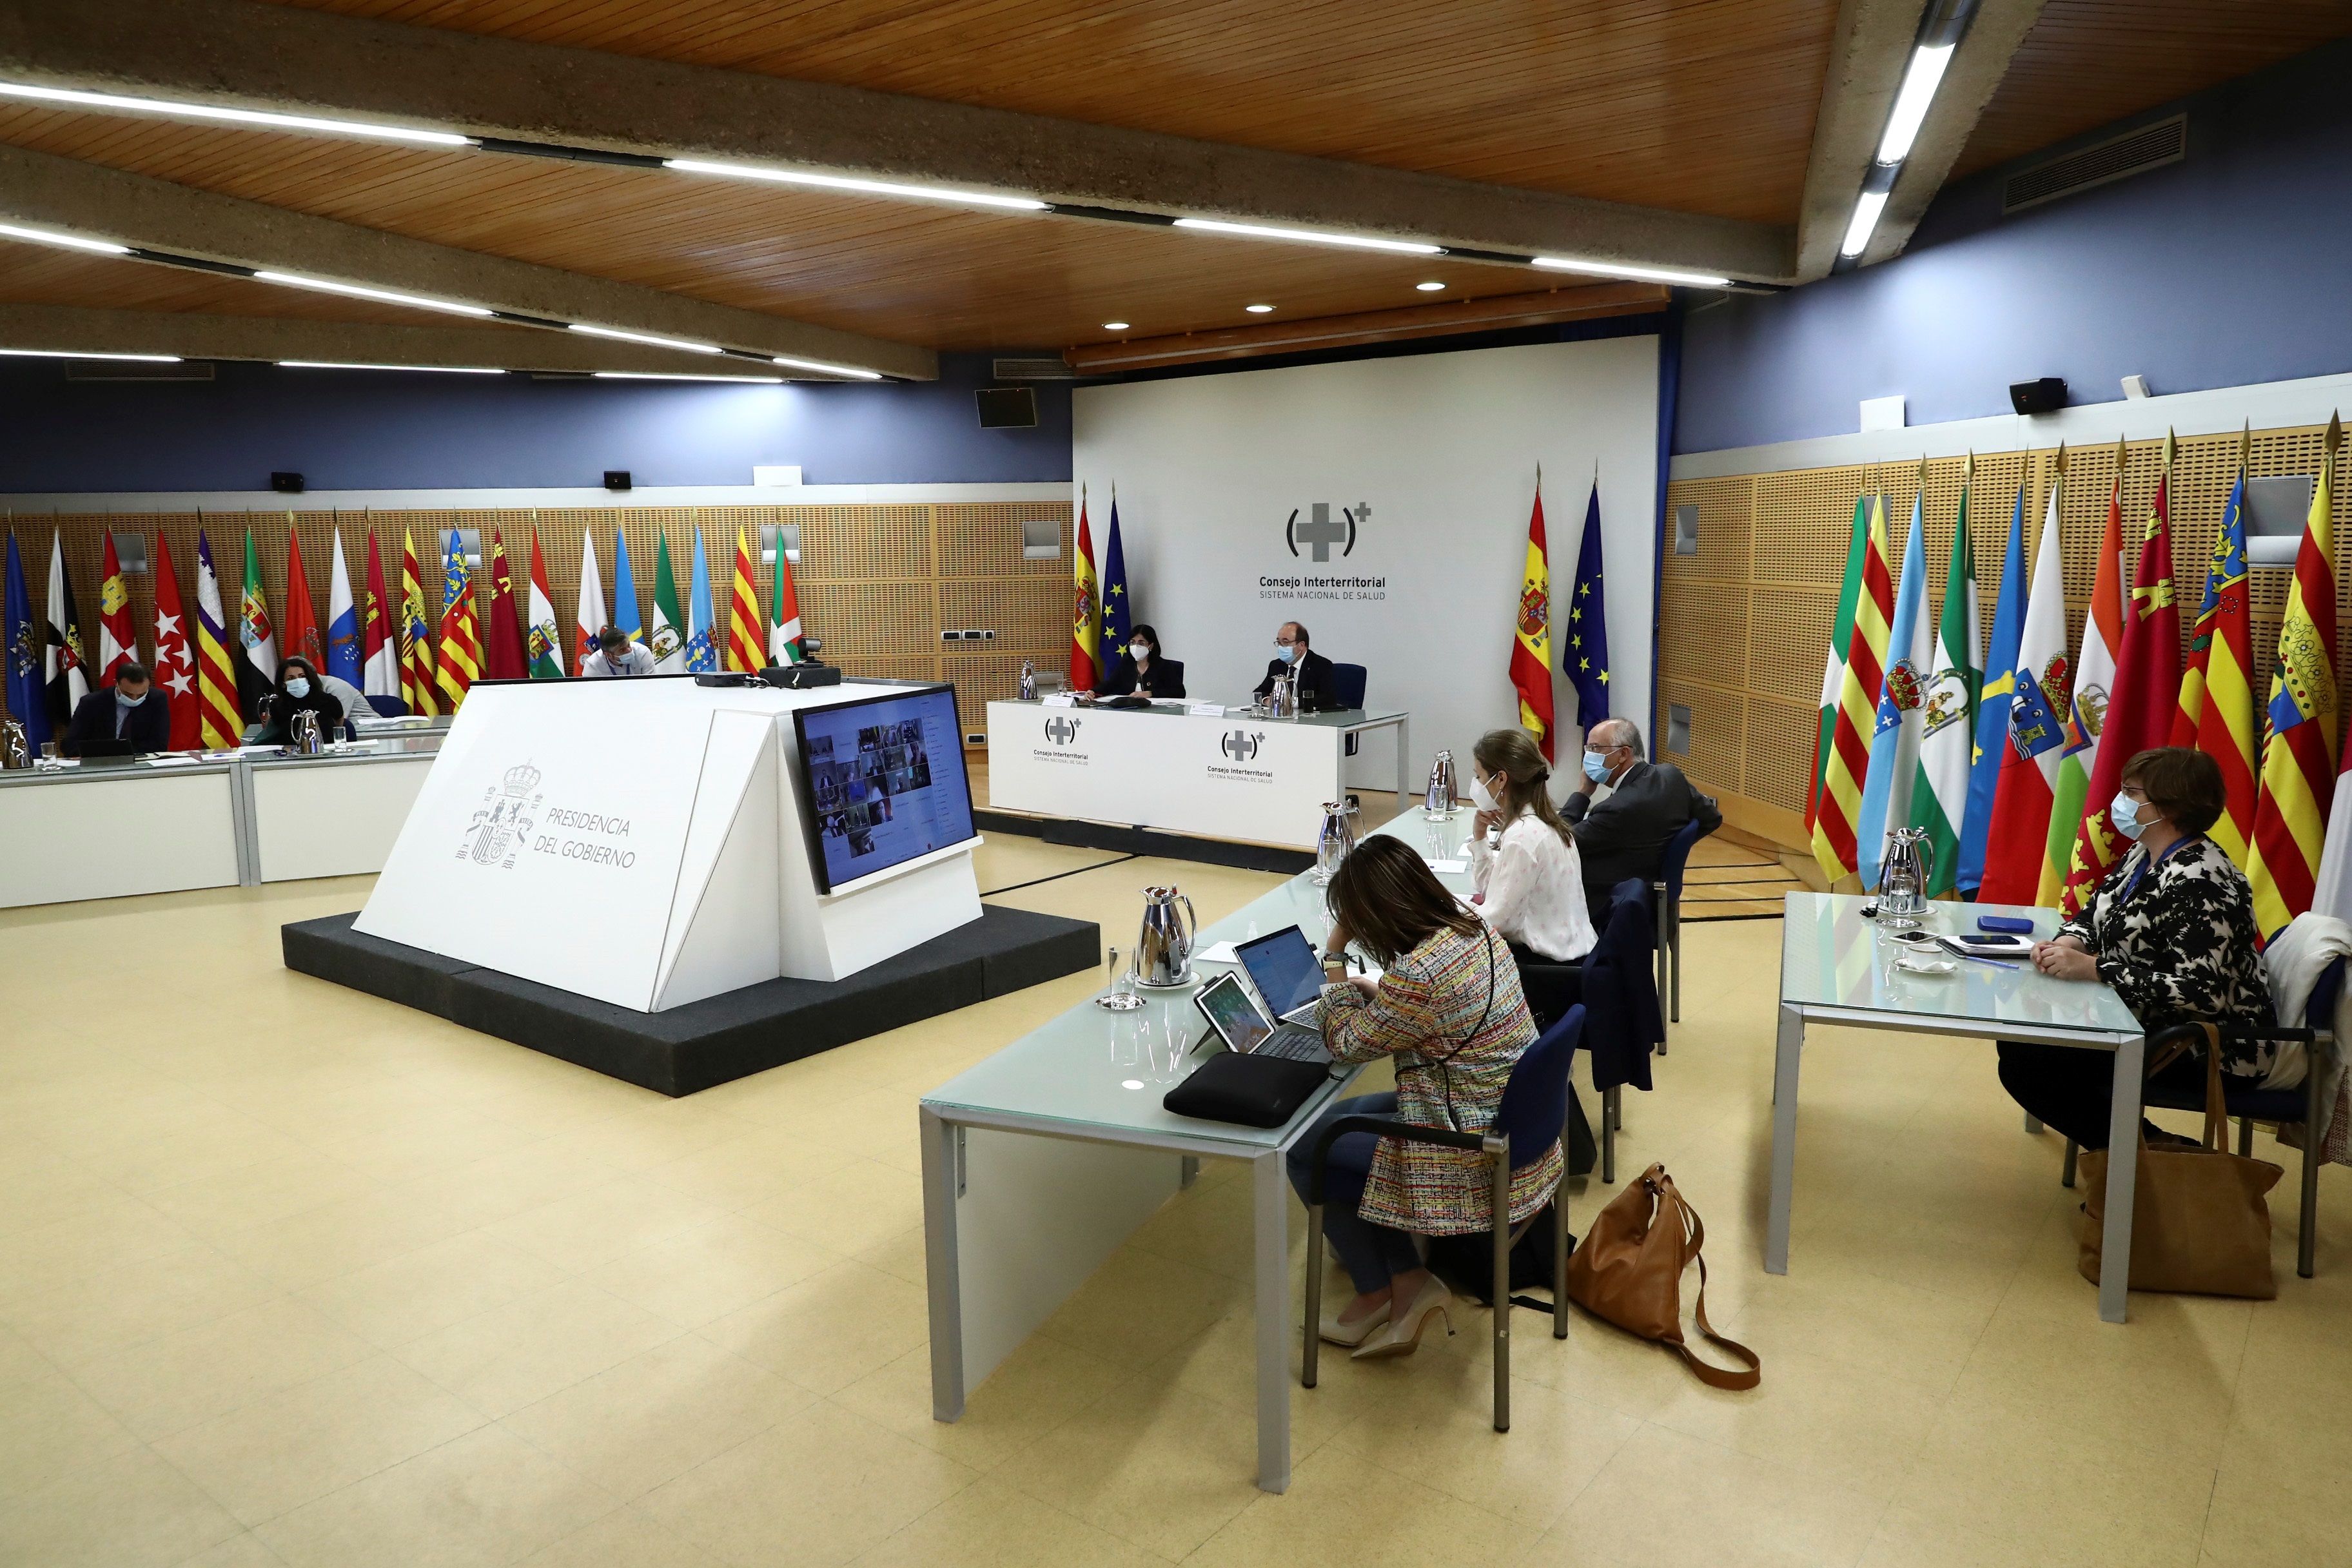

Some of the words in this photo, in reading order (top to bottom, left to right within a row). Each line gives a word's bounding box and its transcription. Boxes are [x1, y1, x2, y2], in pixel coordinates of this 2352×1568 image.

[1259, 576, 1300, 589] Consejo
[1304, 577, 1386, 588] Interterritorial
[1260, 591, 1294, 599] SISTEMA
[1297, 591, 1340, 600] NACIONAL
[1357, 592, 1386, 600] SALUD
[1053, 751, 1088, 760] Interterritorial
[1231, 768, 1273, 777] Interterritorial
[546, 807, 631, 837] PRESIDENCIA
[534, 835, 558, 854] DEL
[562, 840, 636, 869] GOBIERNO
